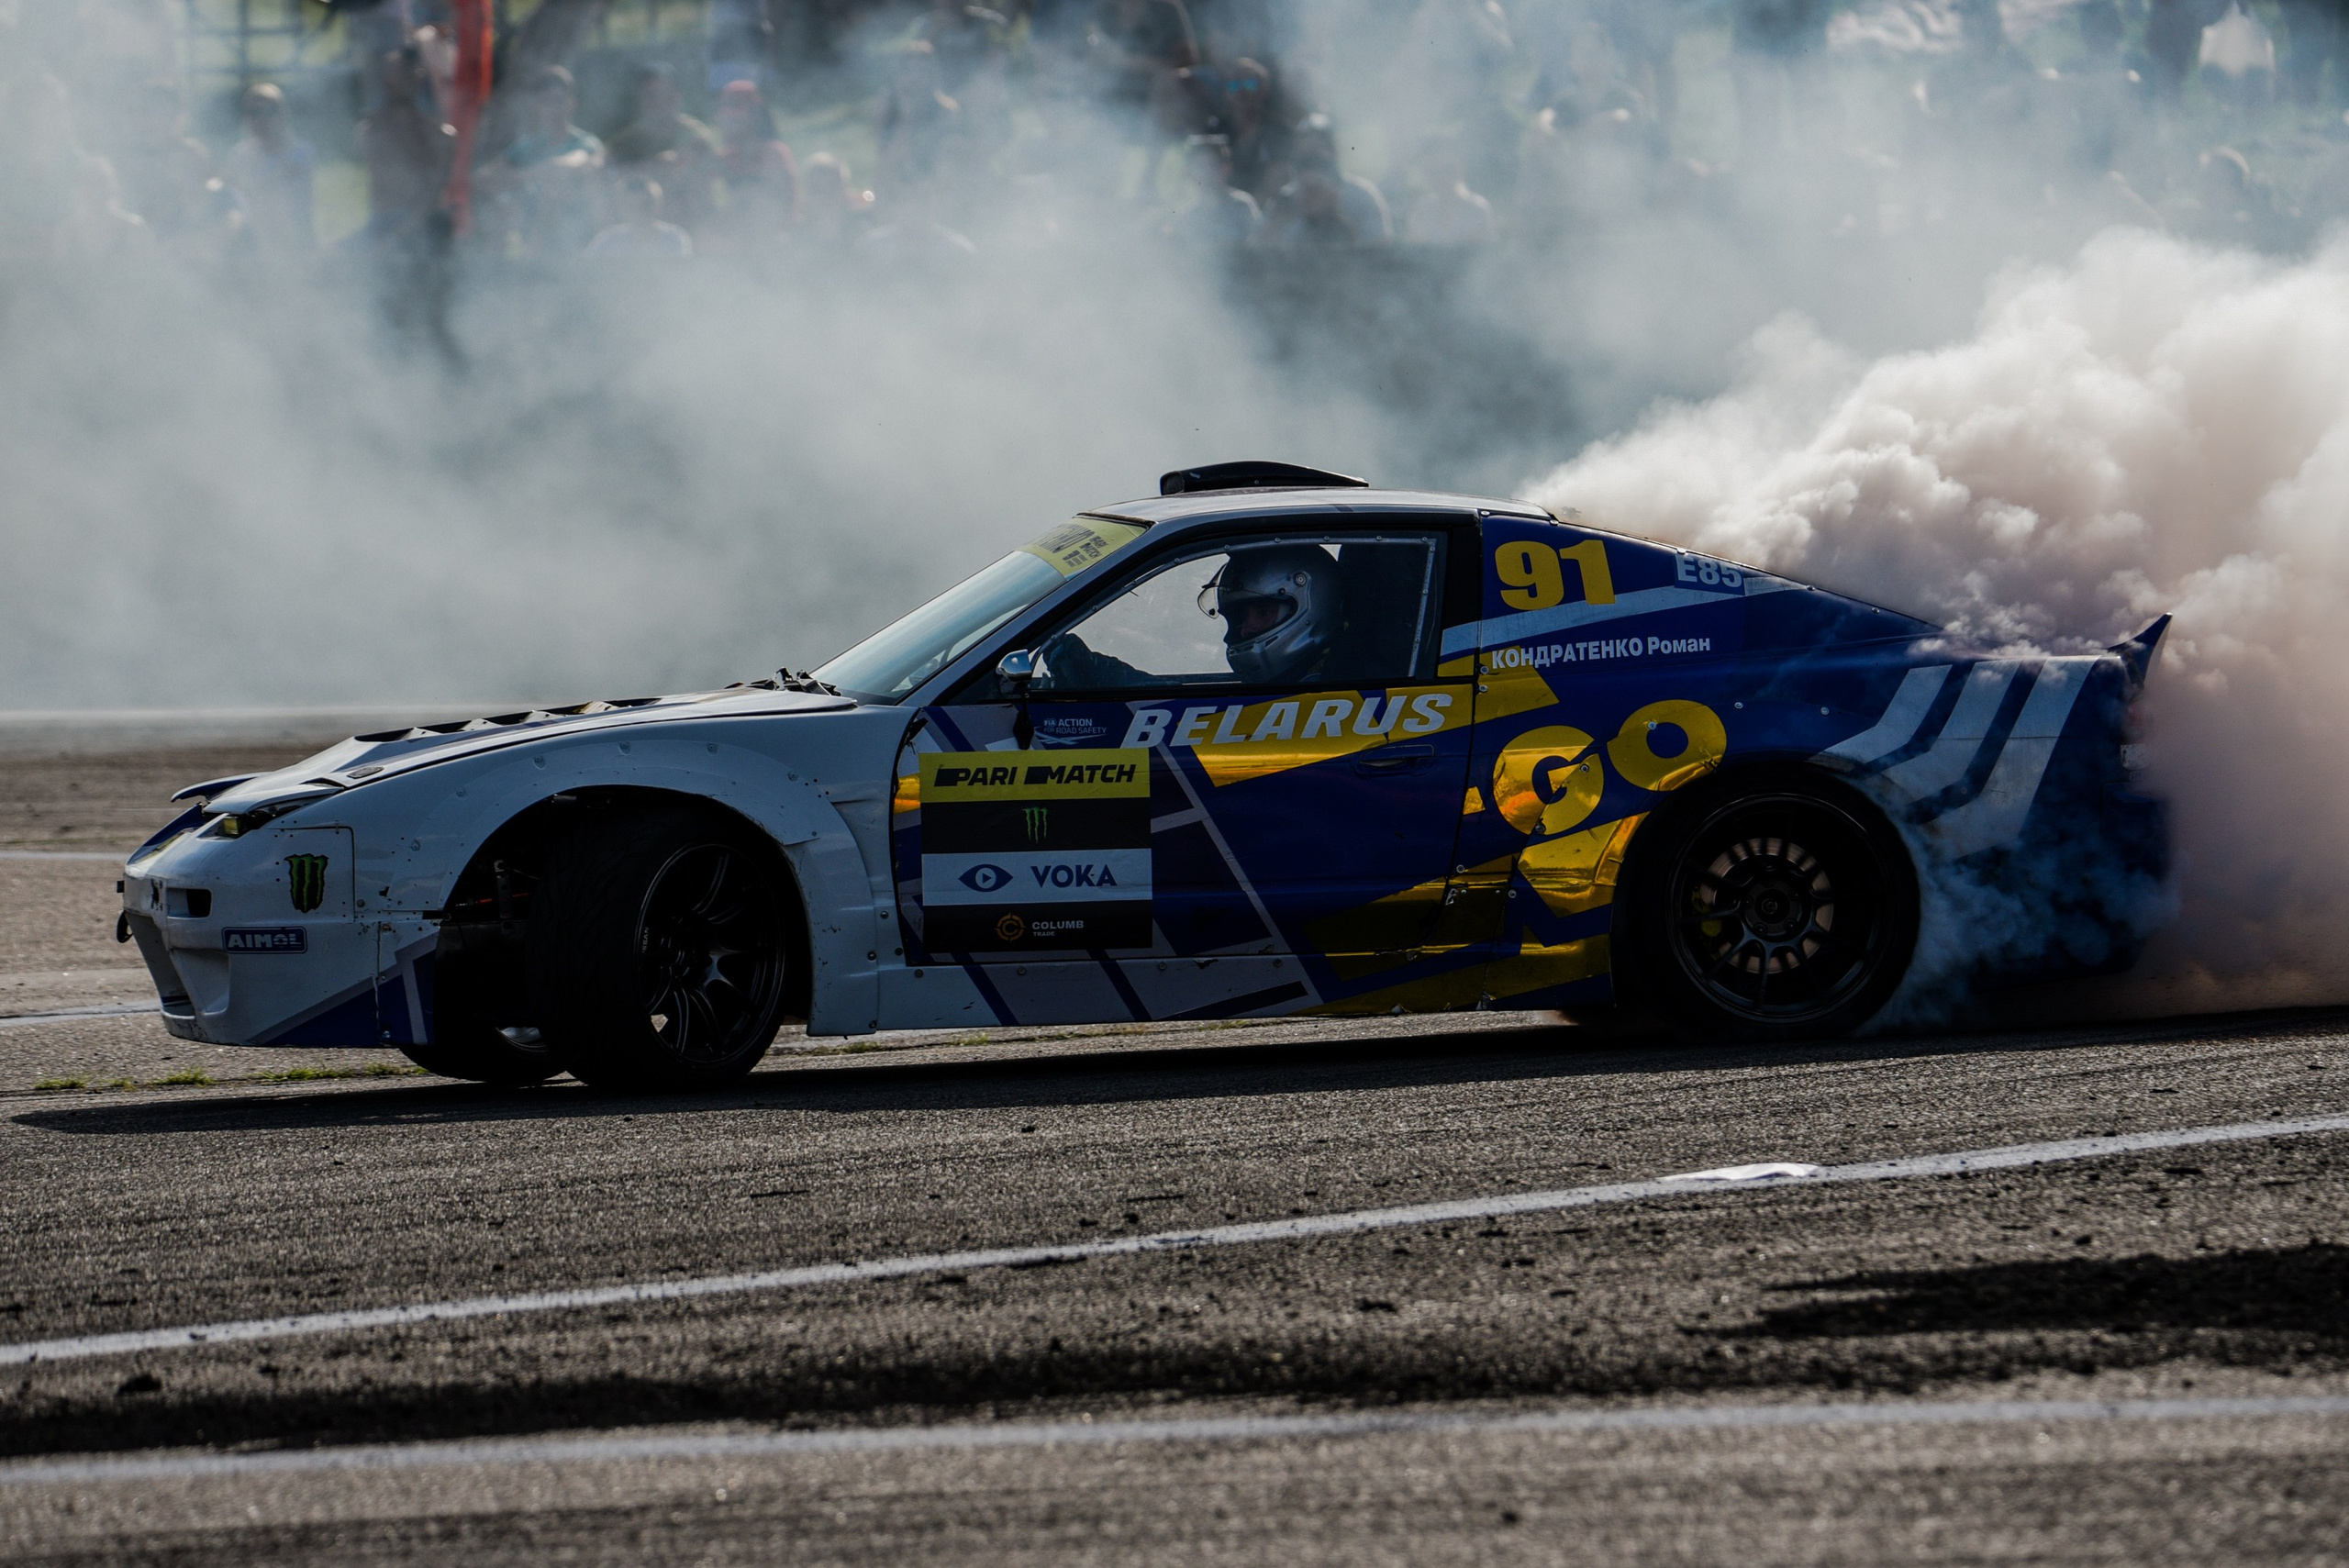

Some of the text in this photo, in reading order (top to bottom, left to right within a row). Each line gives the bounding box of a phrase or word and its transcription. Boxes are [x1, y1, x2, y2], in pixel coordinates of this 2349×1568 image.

[1495, 539, 1616, 611] 91
[1675, 554, 1742, 588] E85
[1492, 635, 1710, 669] КОНДРАТЕНКО Роман
[1058, 717, 1093, 727] ACTION
[1119, 693, 1453, 749] BELARUS
[934, 764, 1136, 786] PARI MATCH
[1030, 864, 1117, 888] VOKA
[1031, 920, 1085, 929] COLUMB
